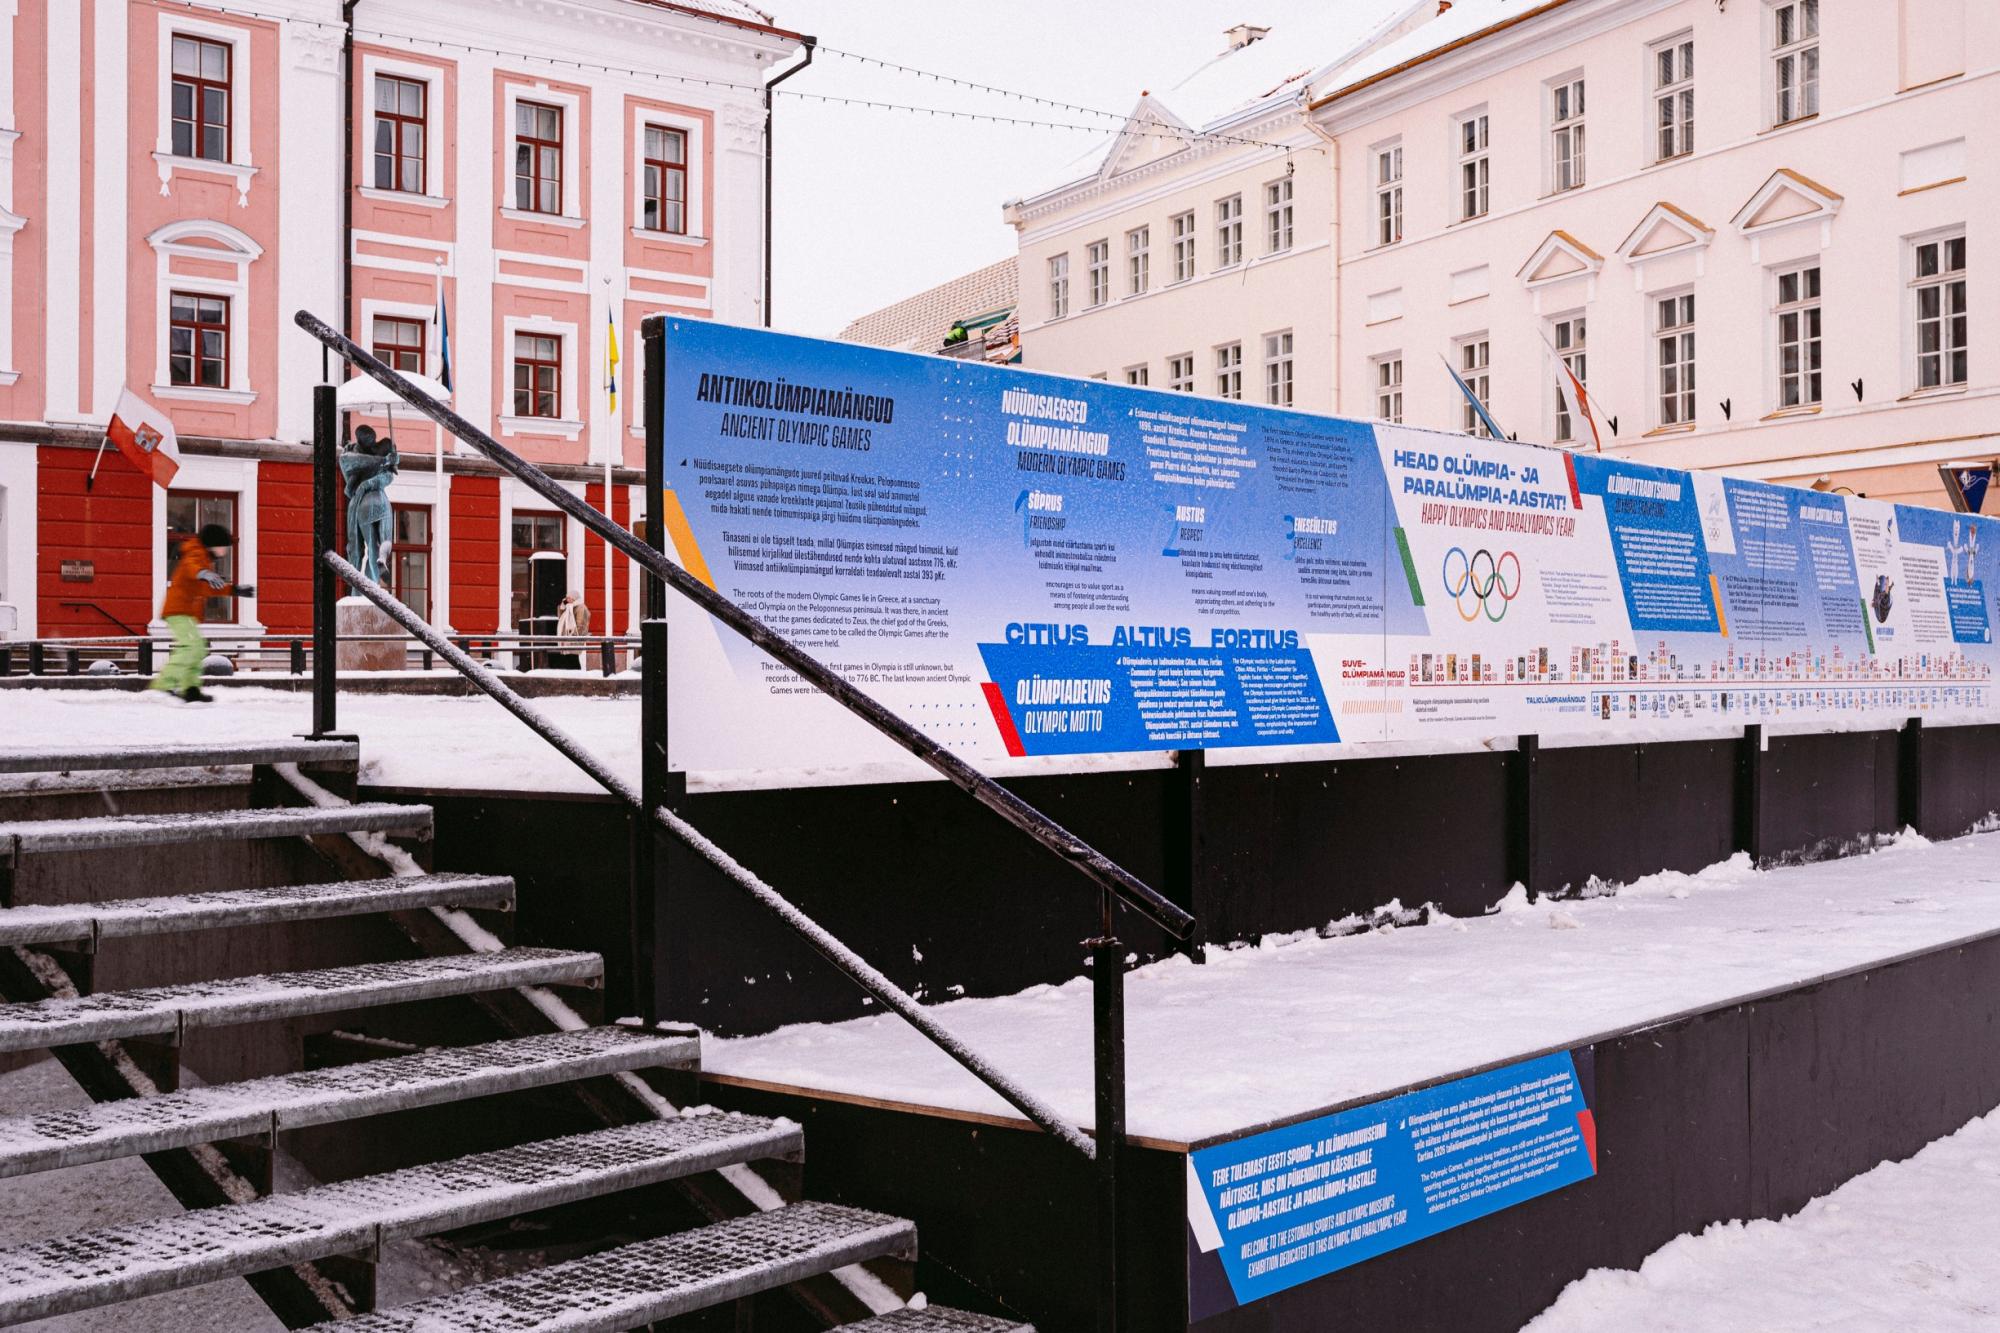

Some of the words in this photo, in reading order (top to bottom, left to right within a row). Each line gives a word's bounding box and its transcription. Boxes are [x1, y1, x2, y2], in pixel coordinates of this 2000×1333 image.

[697, 373, 894, 424] ANTIIKOLÜMPIAMÄNGUD
[1002, 387, 1088, 423] NÜÜDISAEGSED
[720, 413, 775, 440] ANCIENT
[778, 419, 829, 447] OLYMPIC
[832, 426, 872, 451] GAMES
[1007, 419, 1109, 455] OLÜMPIAMÄNGUD
[1018, 451, 1055, 474] MODERN
[1058, 456, 1094, 478] OLYMPIC
[1097, 461, 1125, 481] GAMES
[1394, 450, 1438, 472] HEAD
[1444, 454, 1516, 481] OLÜMPIA-
[1521, 467, 1539, 484] JA
[1028, 490, 1062, 512] SÕPRUS
[1404, 476, 1566, 510] PARALÜMPIA-AASTAT!
[1030, 515, 1066, 531] FRIENDSHIP
[1176, 506, 1204, 523] AUSTUS
[1294, 516, 1337, 534] ENESEÜLETUS
[1422, 503, 1448, 526] HAPPY
[1450, 506, 1488, 529] OLYMPICS
[1489, 510, 1504, 531] AND
[1505, 512, 1554, 536] PARALYMPICS
[1556, 517, 1575, 537] YEAR!
[722, 531, 751, 544] Tänaseni
[752, 533, 759, 545] ei
[760, 534, 770, 545] ole
[772, 534, 795, 549] täpselt
[817, 537, 835, 549] millal
[836, 538, 864, 552] Olümpias
[866, 541, 893, 552] esimesed
[946, 546, 959, 556] kuid
[1180, 528, 1203, 541] RESPECT
[728, 546, 760, 558] hilisemad
[762, 548, 792, 562] kirjalikud
[794, 550, 843, 563] ülestähendused
[844, 554, 862, 564] nende
[864, 554, 881, 565] kohta
[882, 556, 906, 566] ulatuvad
[908, 558, 932, 568] aastasse
[734, 560, 764, 572] Viimased
[835, 565, 865, 577] korraldati
[866, 567, 902, 579] teadaolevalt
[903, 569, 920, 580] aastal
[922, 570, 934, 580] 393
[732, 589, 746, 598] The
[747, 590, 765, 599] roots
[774, 590, 785, 600] the
[786, 591, 811, 601] modern
[812, 592, 839, 604] Olympic
[840, 593, 860, 603] Games
[913, 597, 940, 609] sanctuary
[737, 601, 757, 610] called
[758, 602, 786, 613] Olympia
[797, 603, 808, 612] the
[810, 603, 852, 614] Peloponnesus
[927, 607, 949, 616] ancient
[764, 614, 778, 623] that
[778, 615, 789, 623] the
[790, 617, 812, 626] games
[812, 616, 843, 625] dedicated
[870, 617, 880, 626] the
[881, 618, 896, 626] chief
[896, 618, 908, 628] god
[916, 619, 926, 627] the
[926, 619, 949, 628] Greeks,
[1005, 623, 1089, 645] CITIUS
[1112, 626, 1191, 647] ALTIUS
[1211, 629, 1299, 649] FORTIUS
[1016, 675, 1111, 704] OLÜMPIADEVIIS
[1025, 711, 1068, 734] OLYMPIC
[1070, 710, 1102, 732] MOTTO
[1212, 1167, 1230, 1187] TERE
[1230, 1156, 1268, 1181] TULEMAST
[1268, 1151, 1287, 1171] EESTI
[1287, 1144, 1314, 1165] SPORDI-
[1315, 1140, 1324, 1157] JA
[1325, 1123, 1388, 1155] OLÜMPIAMUUSEUMI
[1430, 1168, 1448, 1179] Olympic
[1464, 1159, 1474, 1167] with
[1474, 1156, 1484, 1164] their
[1493, 1148, 1511, 1157] tradition,
[1554, 1127, 1573, 1137] important
[1220, 1183, 1260, 1208] NÄITUSELE,
[1261, 1178, 1275, 1196] MIS
[1276, 1174, 1287, 1192] ON
[1287, 1162, 1330, 1188] PÜHENDATUD
[1330, 1149, 1373, 1175] KÄESOLEVALE
[1228, 1195, 1292, 1230] OLÜMPIA-AASTALE
[1293, 1192, 1302, 1209] JA
[1303, 1169, 1377, 1206] PARALÜMPIA-AASTALE!
[1241, 1237, 1269, 1259] WELCOME
[1270, 1235, 1277, 1249] TO
[1277, 1231, 1287, 1247] THE
[1287, 1222, 1314, 1243] ESTONIAN
[1314, 1216, 1334, 1234] SPORTS
[1334, 1212, 1347, 1227] AND
[1347, 1204, 1369, 1223] OLYMPIC
[1368, 1195, 1395, 1216] MUSEUM'S
[1248, 1255, 1279, 1278] EXHIBITION
[1279, 1245, 1307, 1267] DEDICATED
[1307, 1242, 1315, 1257] TO
[1315, 1238, 1328, 1254] THIS
[1327, 1230, 1350, 1250] OLYMPIC
[1350, 1226, 1362, 1242] AND
[1362, 1215, 1393, 1238] PARALYMPIC
[1393, 1210, 1408, 1227] YEAR!
